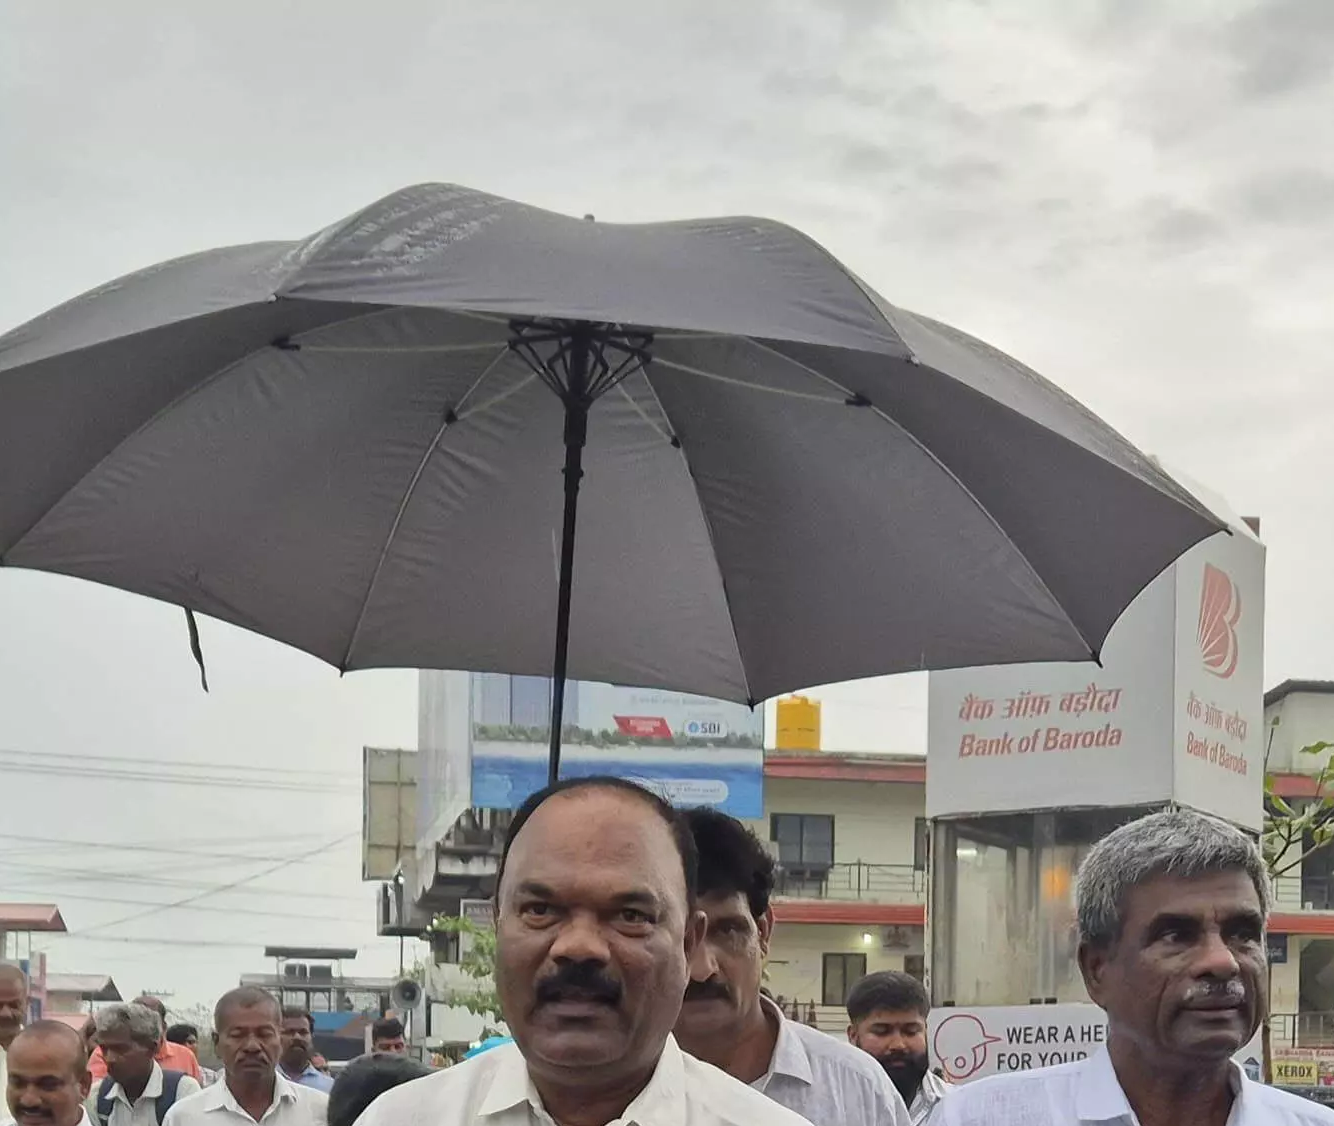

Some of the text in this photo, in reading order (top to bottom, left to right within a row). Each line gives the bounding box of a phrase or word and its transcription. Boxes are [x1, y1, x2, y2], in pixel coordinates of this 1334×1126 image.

[958, 723, 1123, 758] Bank of Baroda
[1187, 731, 1247, 775] Bank of Baroda
[1007, 1024, 1108, 1044] WEAR A HE
[997, 1052, 1033, 1070] FOR
[1276, 1064, 1313, 1078] XEROX
